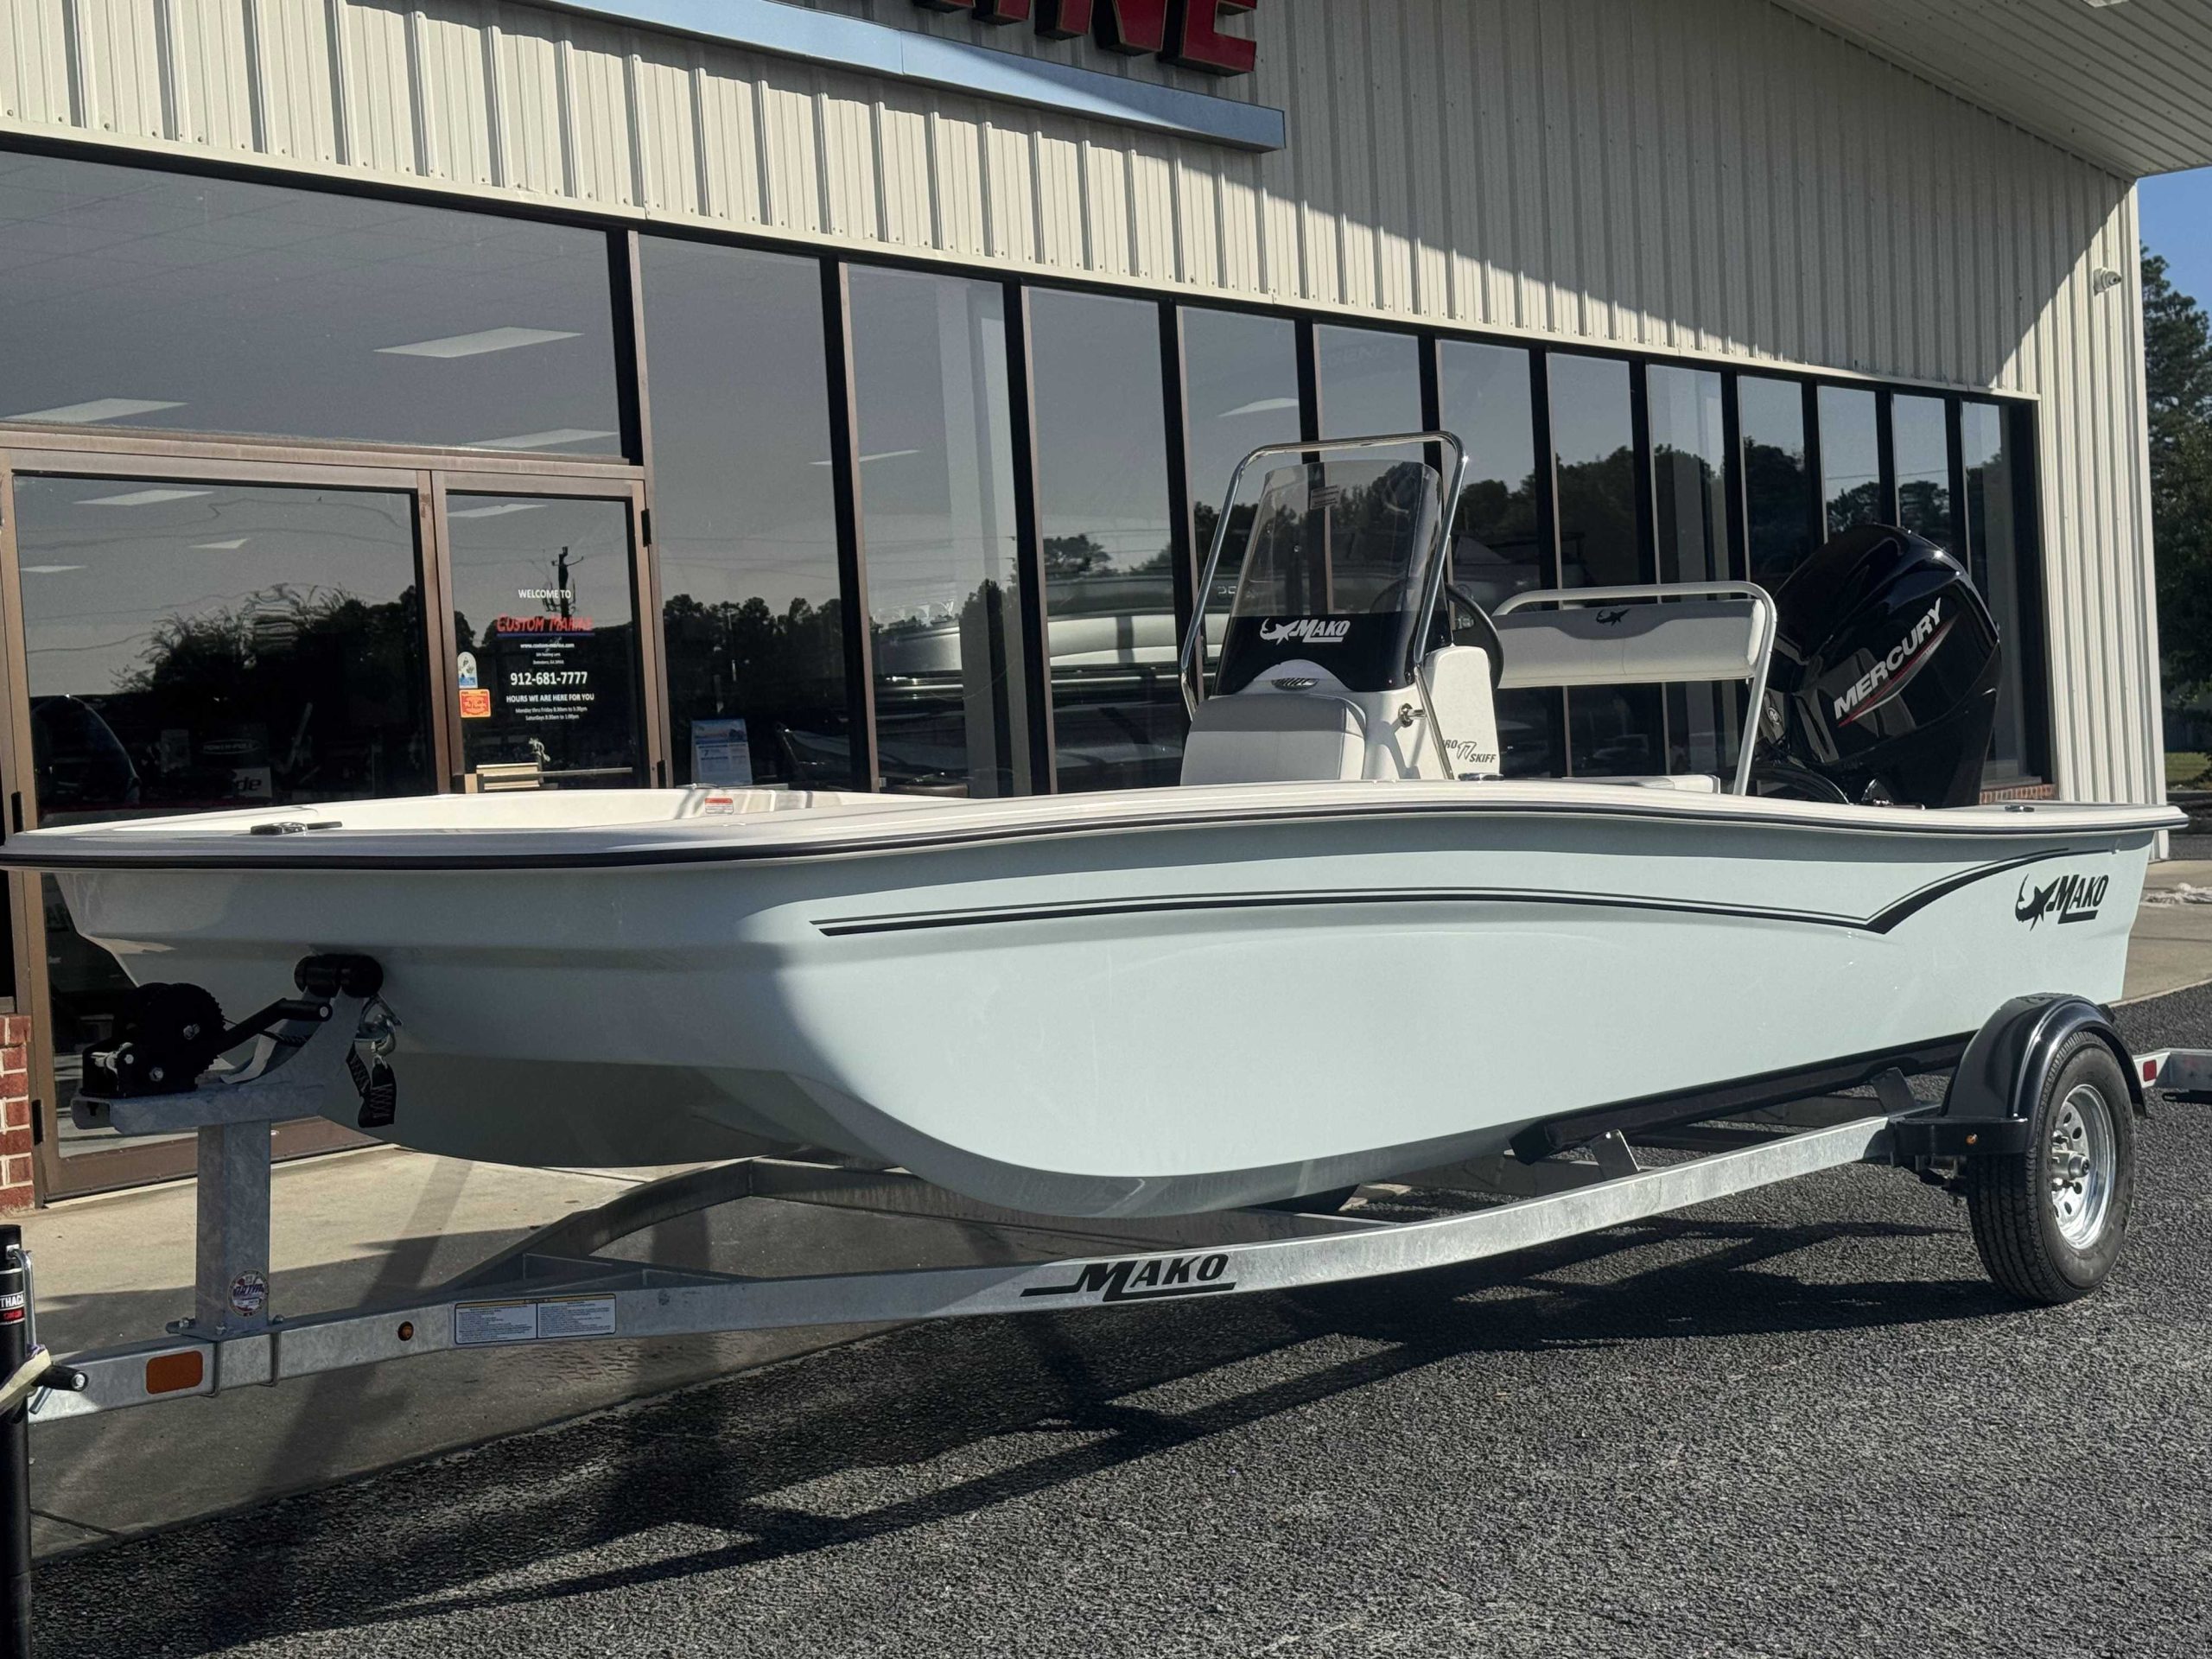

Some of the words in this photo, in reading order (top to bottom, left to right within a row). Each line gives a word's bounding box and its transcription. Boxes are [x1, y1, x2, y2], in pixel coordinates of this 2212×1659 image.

[518, 589, 558, 598] WELCOME
[560, 588, 571, 599] TO
[496, 614, 544, 632] CUSTOM
[1288, 620, 1351, 643] MAKO
[1834, 597, 1941, 720] MERCURY
[510, 671, 588, 686] 912-681-7777
[505, 695, 528, 703] HOURS
[539, 694, 552, 702] ARE
[552, 694, 568, 702] HERE
[581, 693, 594, 702] YOU
[1457, 741, 1477, 760] 17
[1469, 753, 1497, 763] SKIFF
[2045, 874, 2109, 925] MAKO
[1020, 1254, 1236, 1302] MAKO
